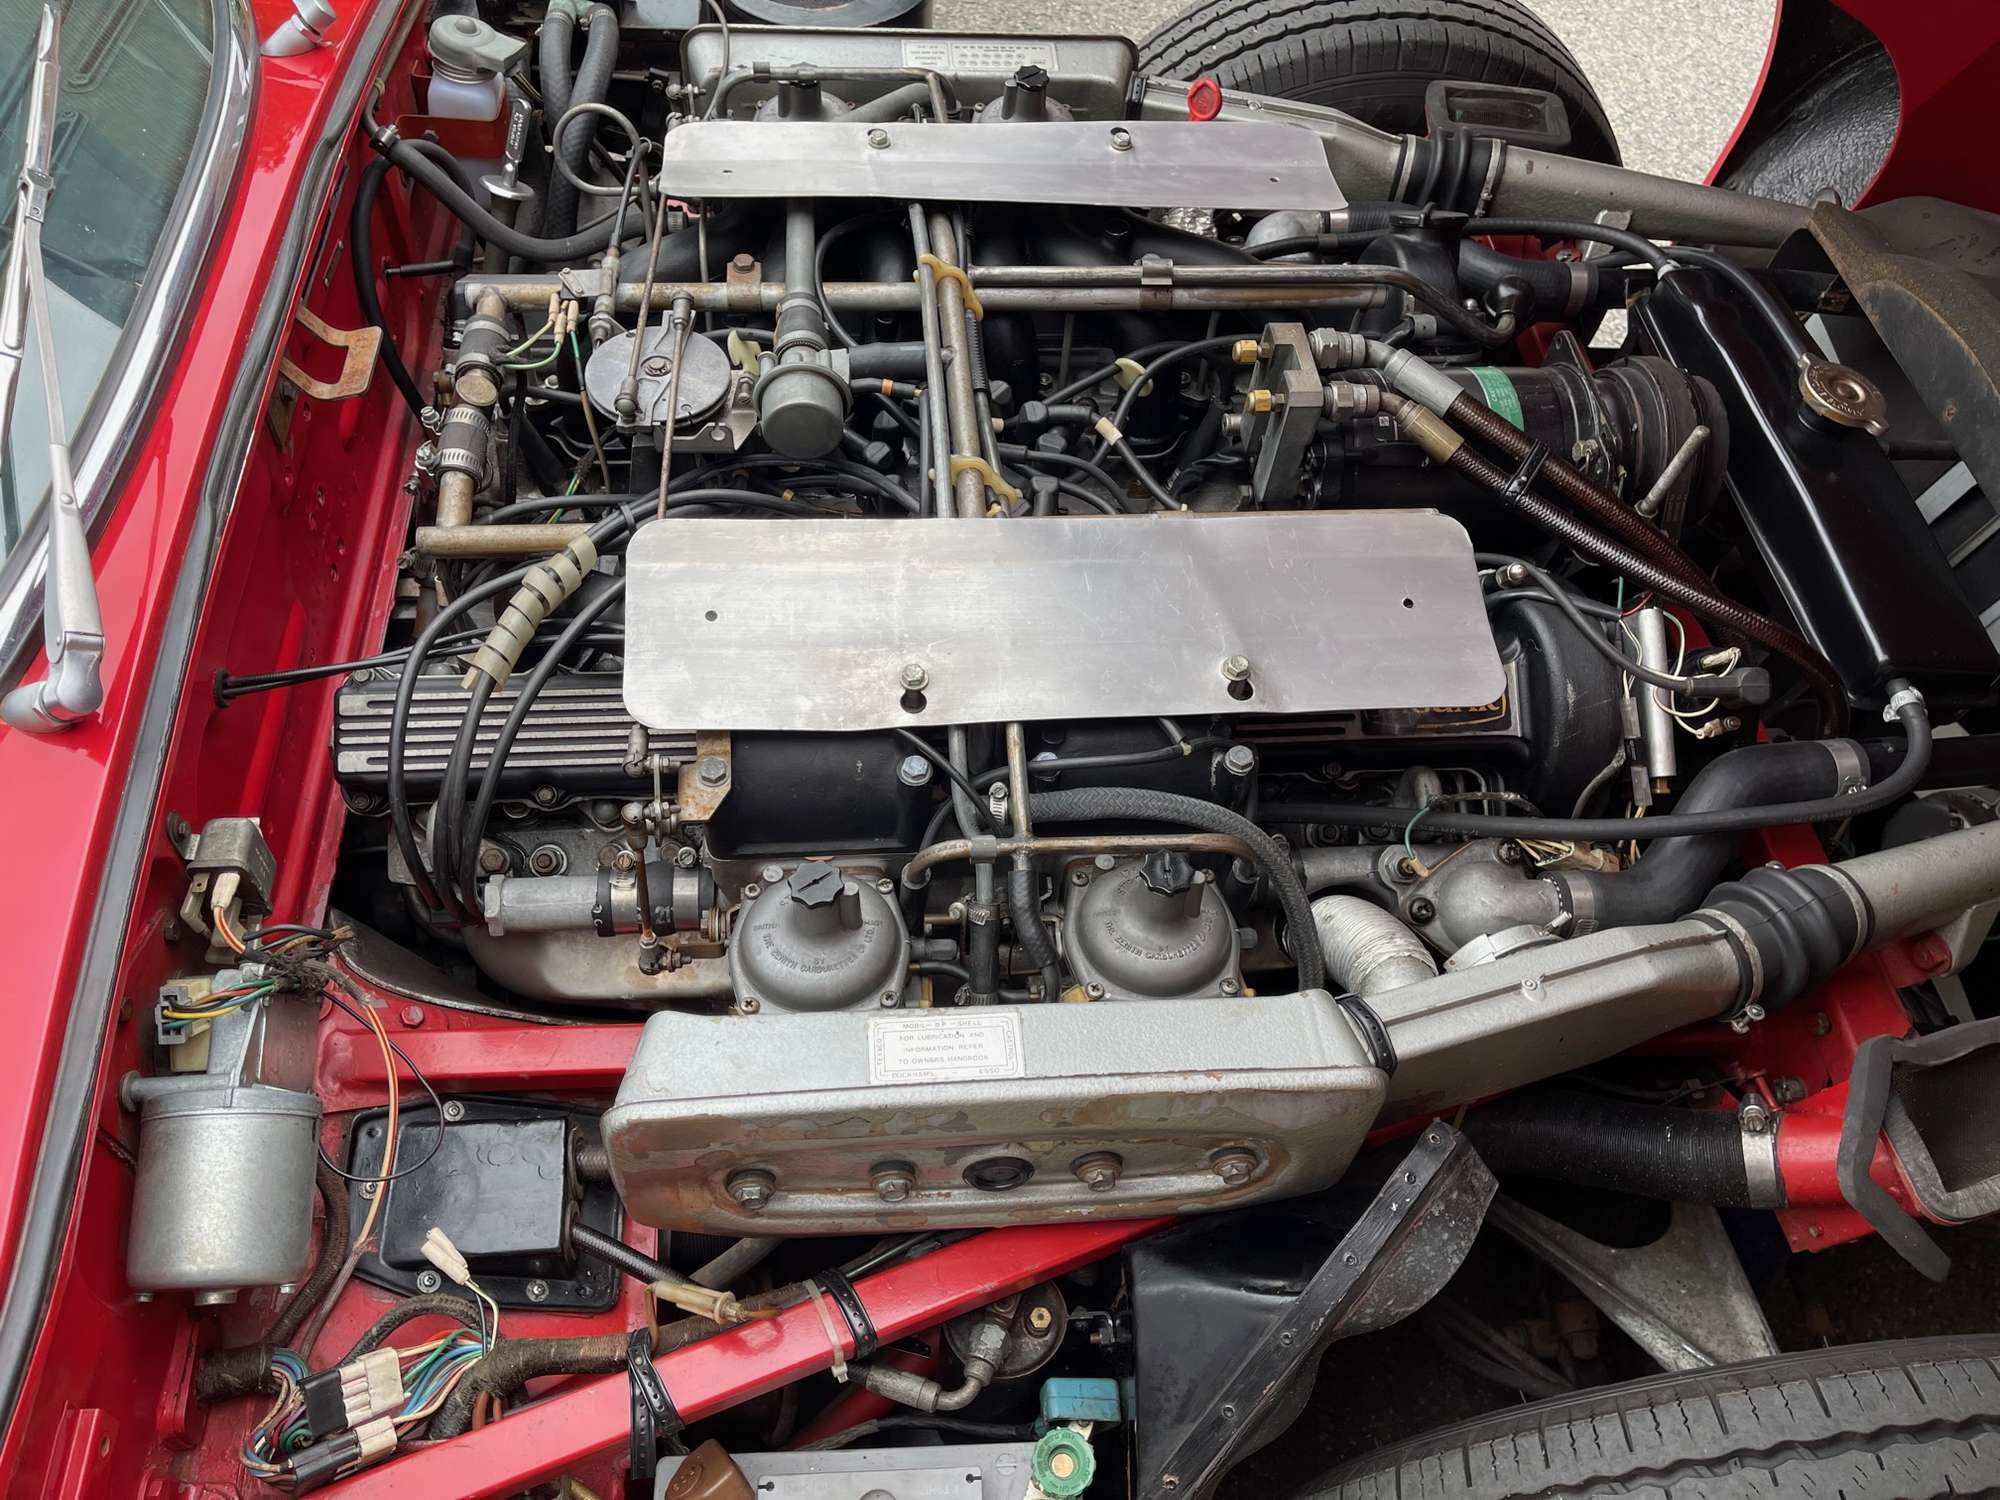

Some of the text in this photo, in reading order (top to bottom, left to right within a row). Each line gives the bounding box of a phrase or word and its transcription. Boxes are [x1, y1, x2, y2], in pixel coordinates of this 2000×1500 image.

[763, 934, 775, 950] THE
[771, 950, 797, 969] ZENITH
[917, 1033, 965, 1041] LUBRICATION
